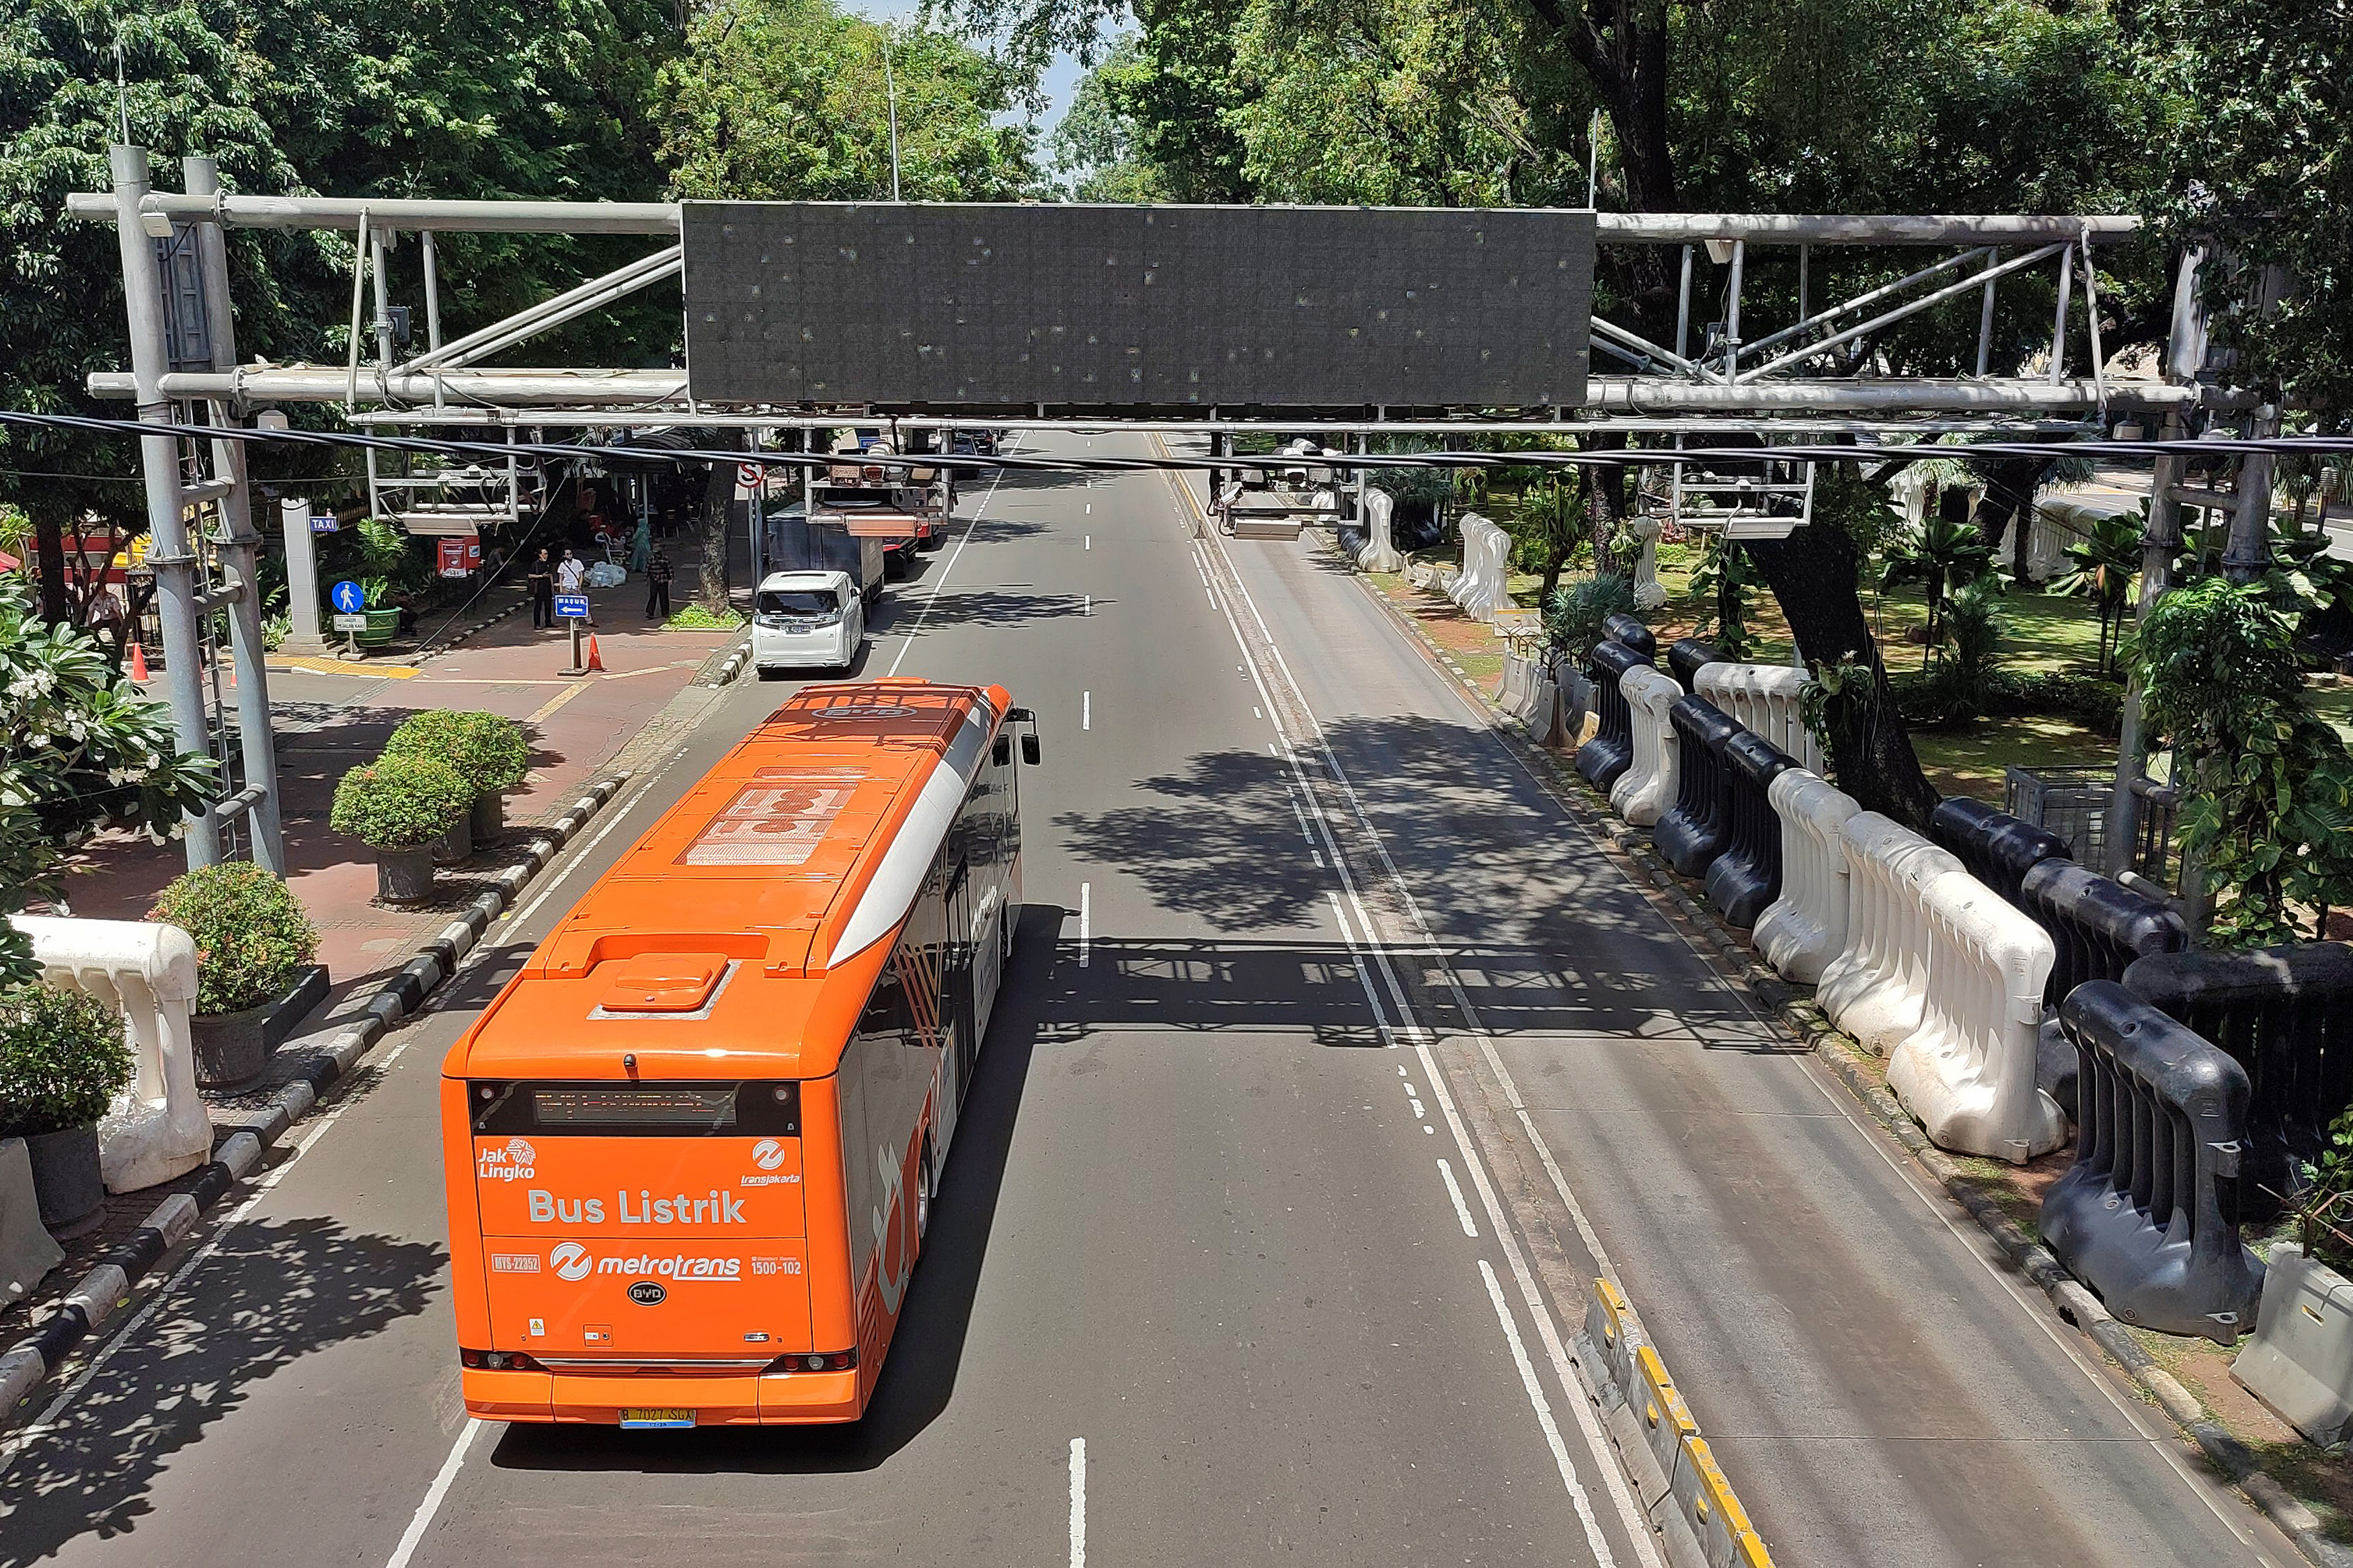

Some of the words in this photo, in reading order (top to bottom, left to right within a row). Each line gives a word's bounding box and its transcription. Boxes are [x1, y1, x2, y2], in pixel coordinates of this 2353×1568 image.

[311, 519, 335, 529] TAXI
[478, 1147, 508, 1163] Jak
[479, 1163, 535, 1182] Lingko
[740, 1174, 800, 1187] transjakarta
[528, 1189, 605, 1223] Bus
[618, 1189, 747, 1224] Listrik
[597, 1253, 742, 1282] metrotrans
[751, 1261, 801, 1275] 1500-102
[633, 1288, 662, 1298] BYD
[623, 1409, 629, 1420] B
[636, 1409, 664, 1420] 7027
[671, 1409, 692, 1420] SGX
